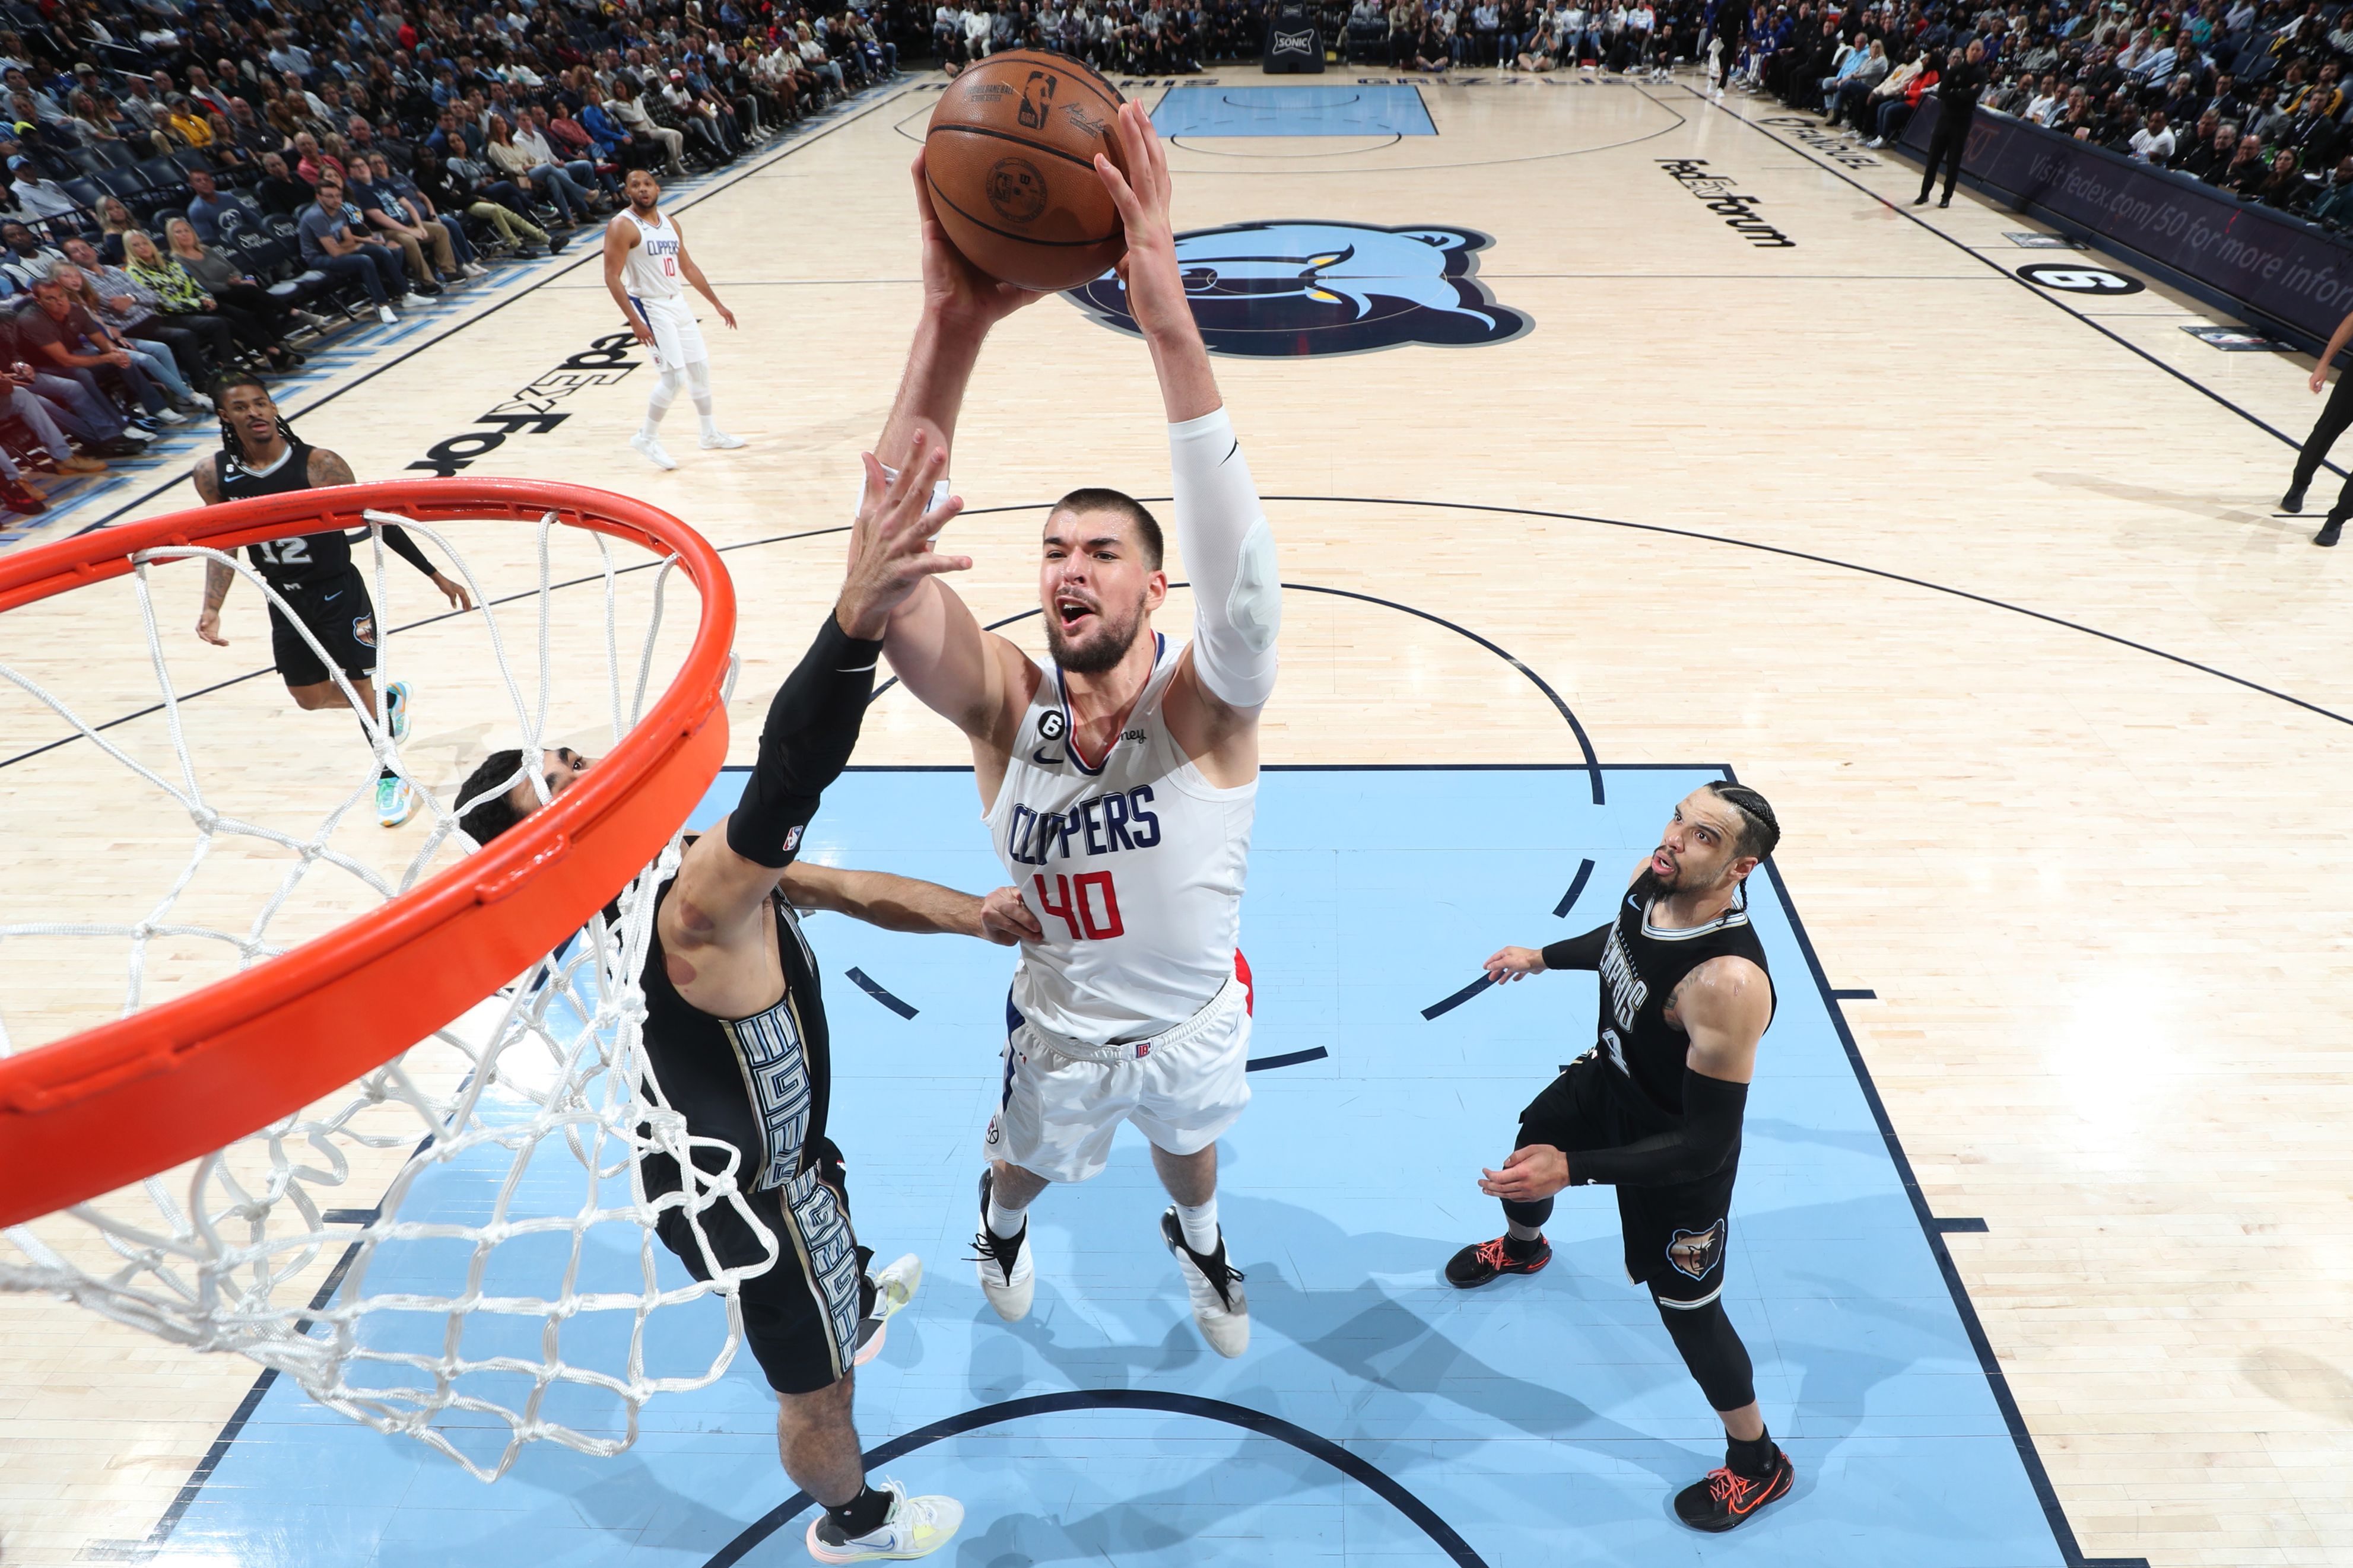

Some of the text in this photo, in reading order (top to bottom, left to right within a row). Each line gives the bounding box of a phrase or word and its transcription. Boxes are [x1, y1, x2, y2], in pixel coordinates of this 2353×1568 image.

[1278, 37, 1308, 47] SONIC
[1783, 128, 1883, 170] FANDUEL
[1654, 160, 1796, 247] FedExForum
[2028, 153, 2065, 186] Visit
[2060, 166, 2189, 237] fedex.com/50
[2185, 215, 2221, 252] for
[2216, 236, 2284, 279] more
[647, 240, 679, 256] CLIPPERS
[663, 257, 675, 276] 10
[260, 537, 313, 564] 12
[1042, 714, 1062, 737] 6
[1009, 784, 1161, 866] CLIPPERS
[1033, 870, 1125, 940] 40
